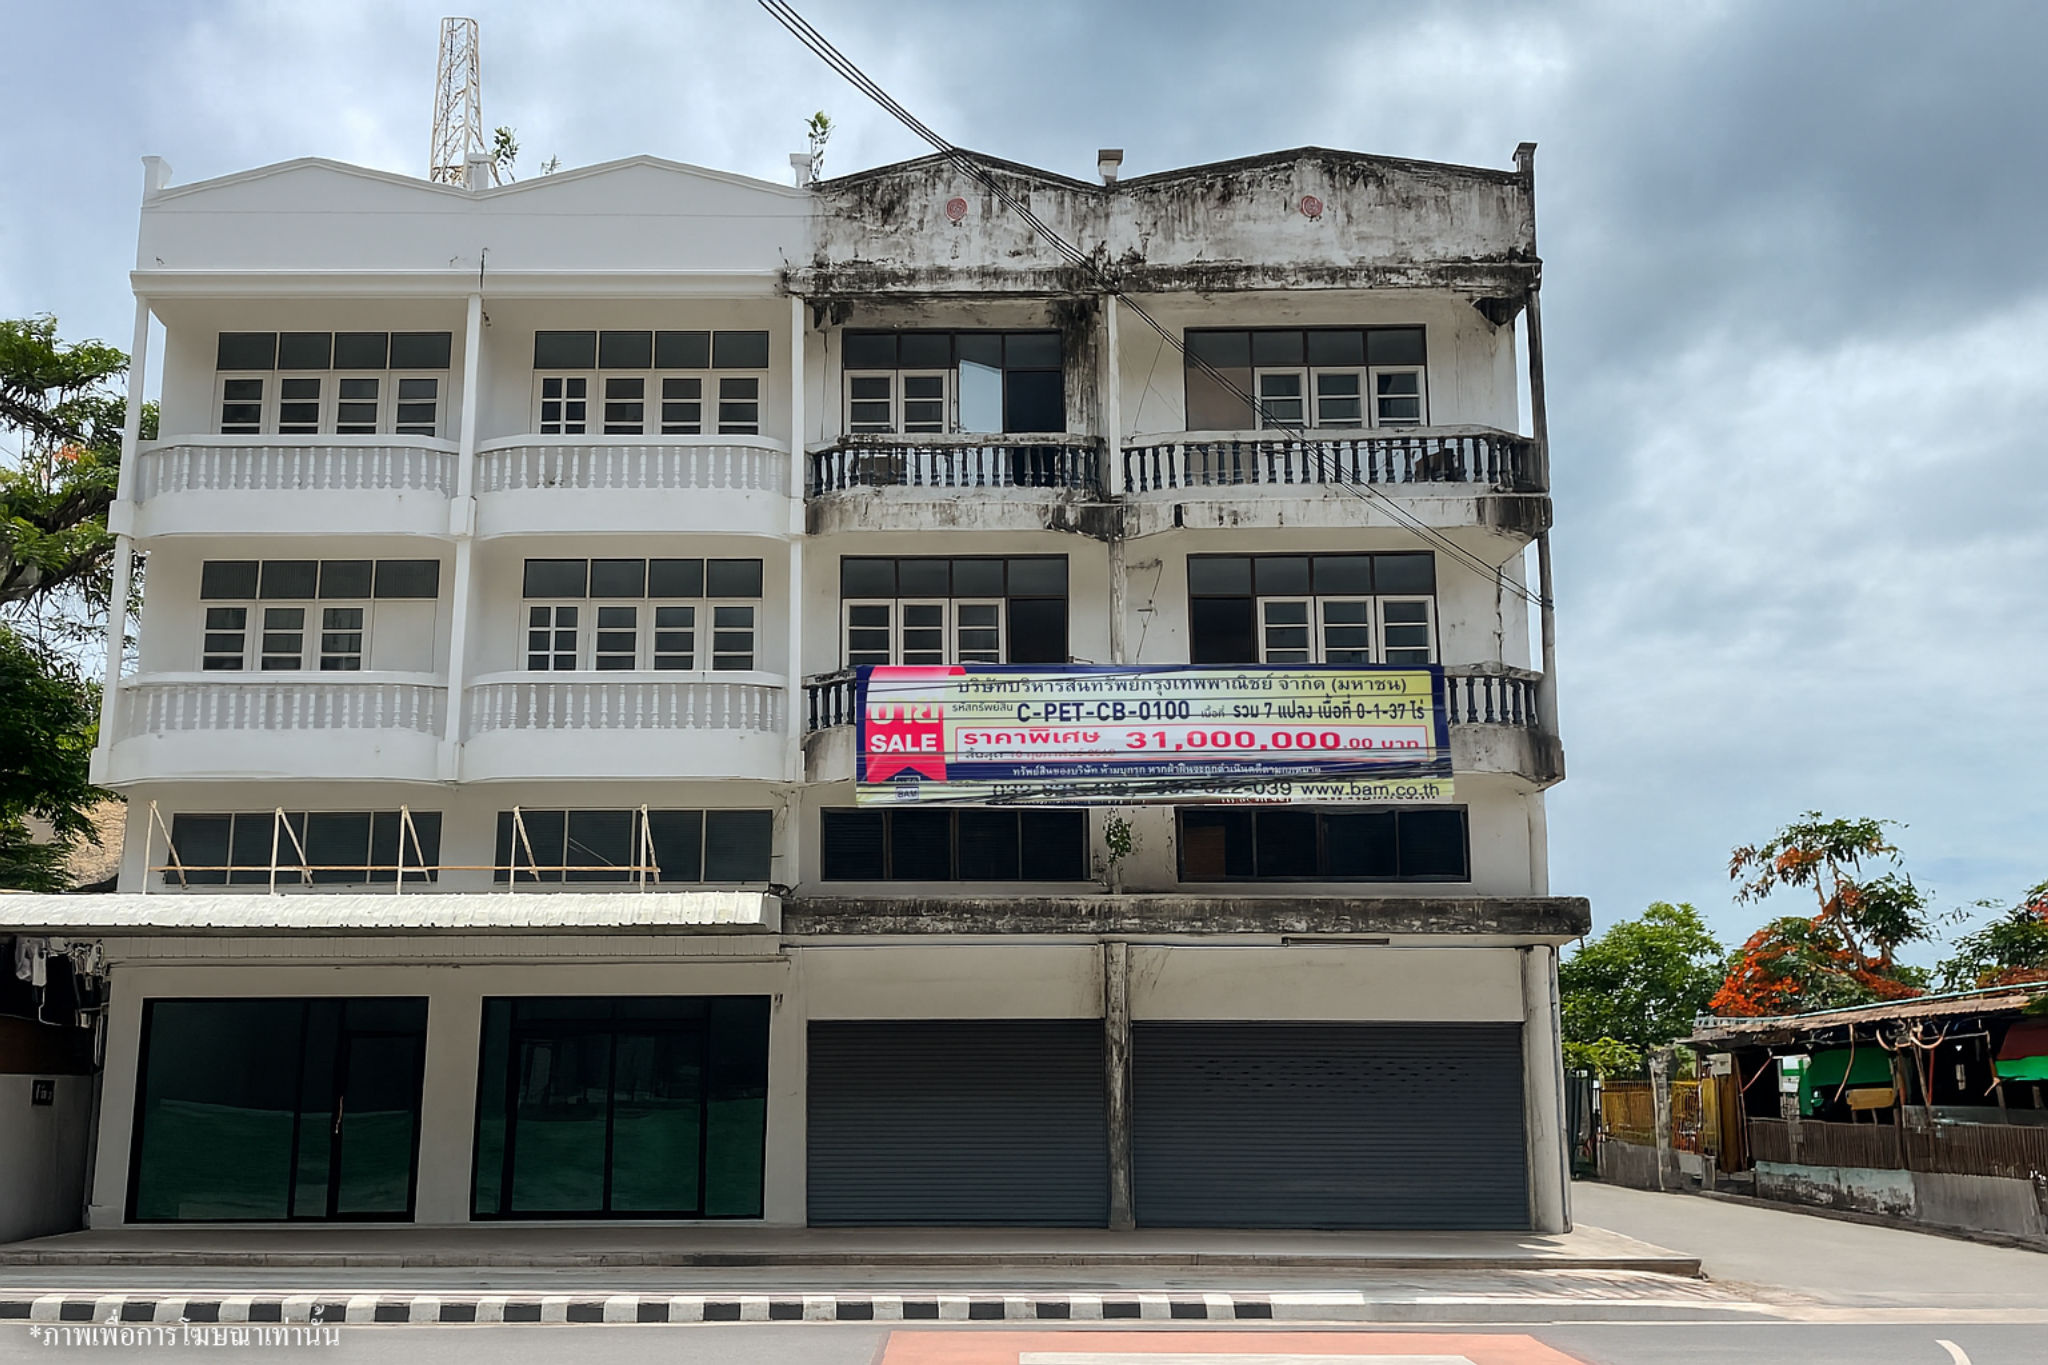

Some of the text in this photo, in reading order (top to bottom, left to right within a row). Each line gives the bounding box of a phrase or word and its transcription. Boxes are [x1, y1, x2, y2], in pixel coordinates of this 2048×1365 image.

[1279, 674, 1325, 690] จำกัด
[1331, 678, 1407, 693] (มหาชน)
[1017, 700, 1190, 722] C-PET-CB-0100
[1233, 704, 1260, 719] รวม
[1264, 702, 1273, 719] 7
[1278, 699, 1313, 719] แปลง
[1356, 703, 1406, 720] 0-1-37
[870, 733, 937, 753] SALE
[964, 729, 1101, 745] ราคาพิเศษ
[1300, 782, 1440, 796] www.bam.co.th
